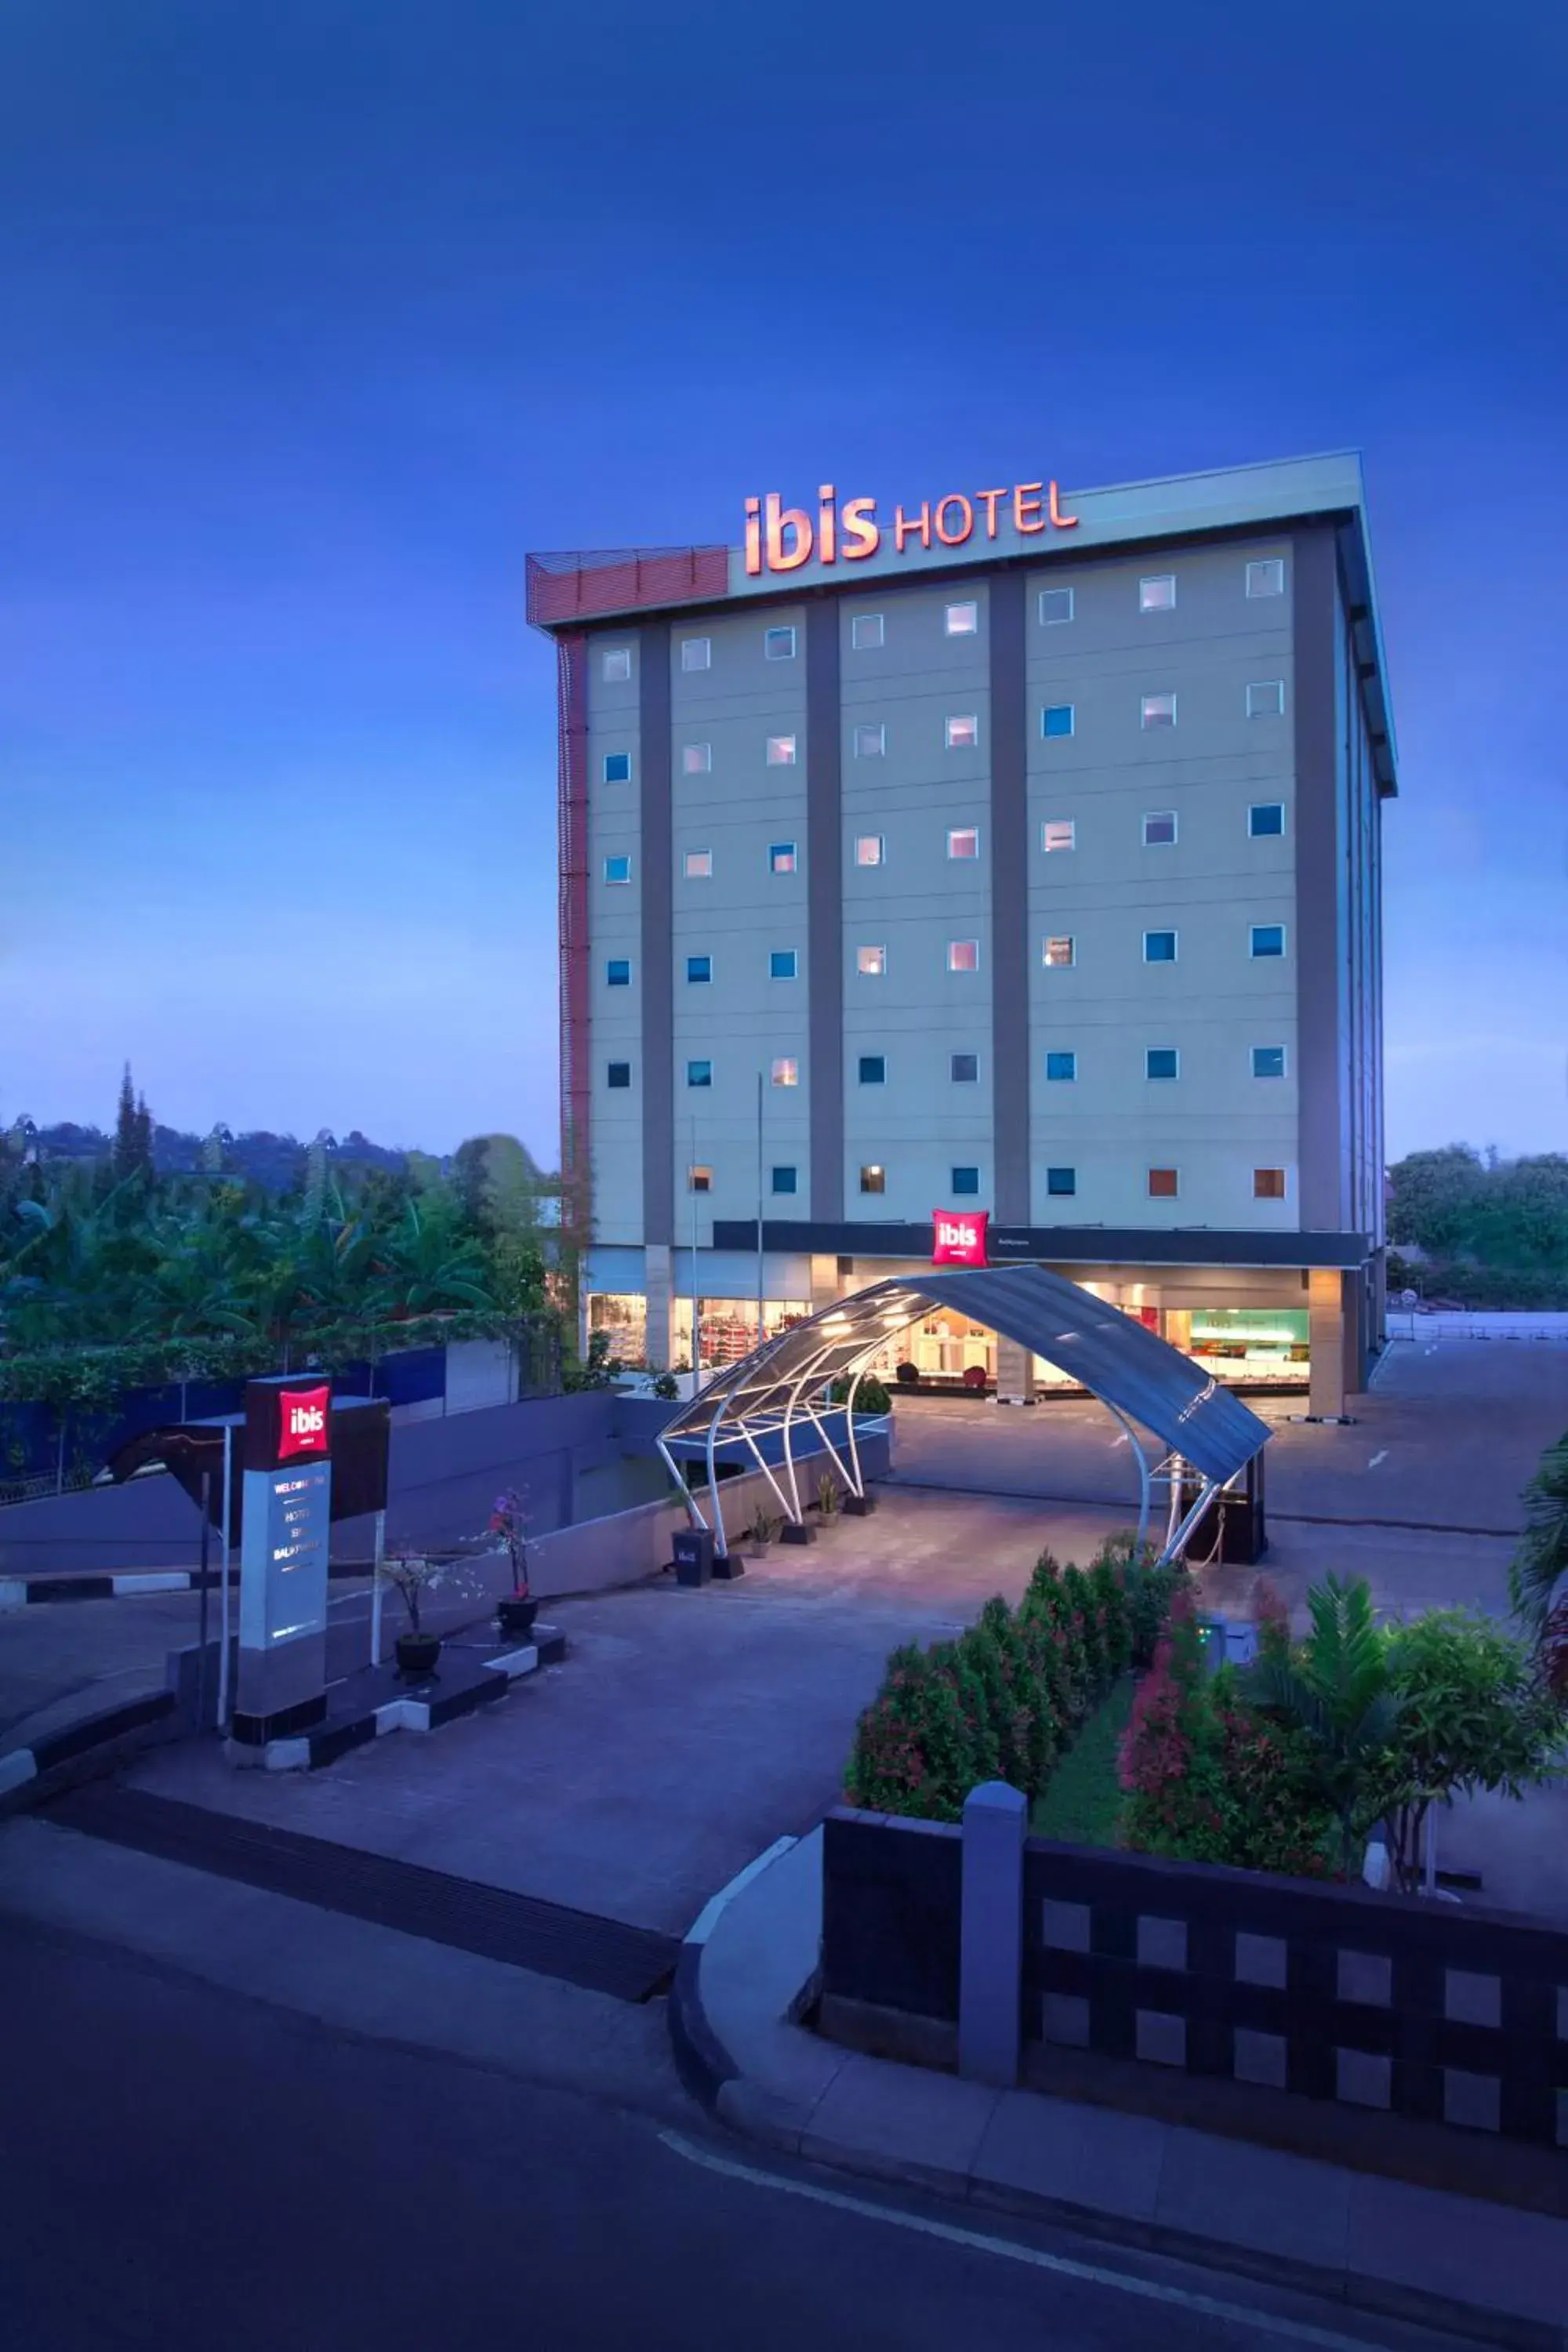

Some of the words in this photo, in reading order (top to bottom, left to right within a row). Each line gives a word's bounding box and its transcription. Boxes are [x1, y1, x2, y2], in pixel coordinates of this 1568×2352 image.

[744, 484, 880, 575] ibis
[895, 480, 1079, 552] HOTEL
[939, 1223, 977, 1247] ibis
[291, 1406, 324, 1434] ibis
